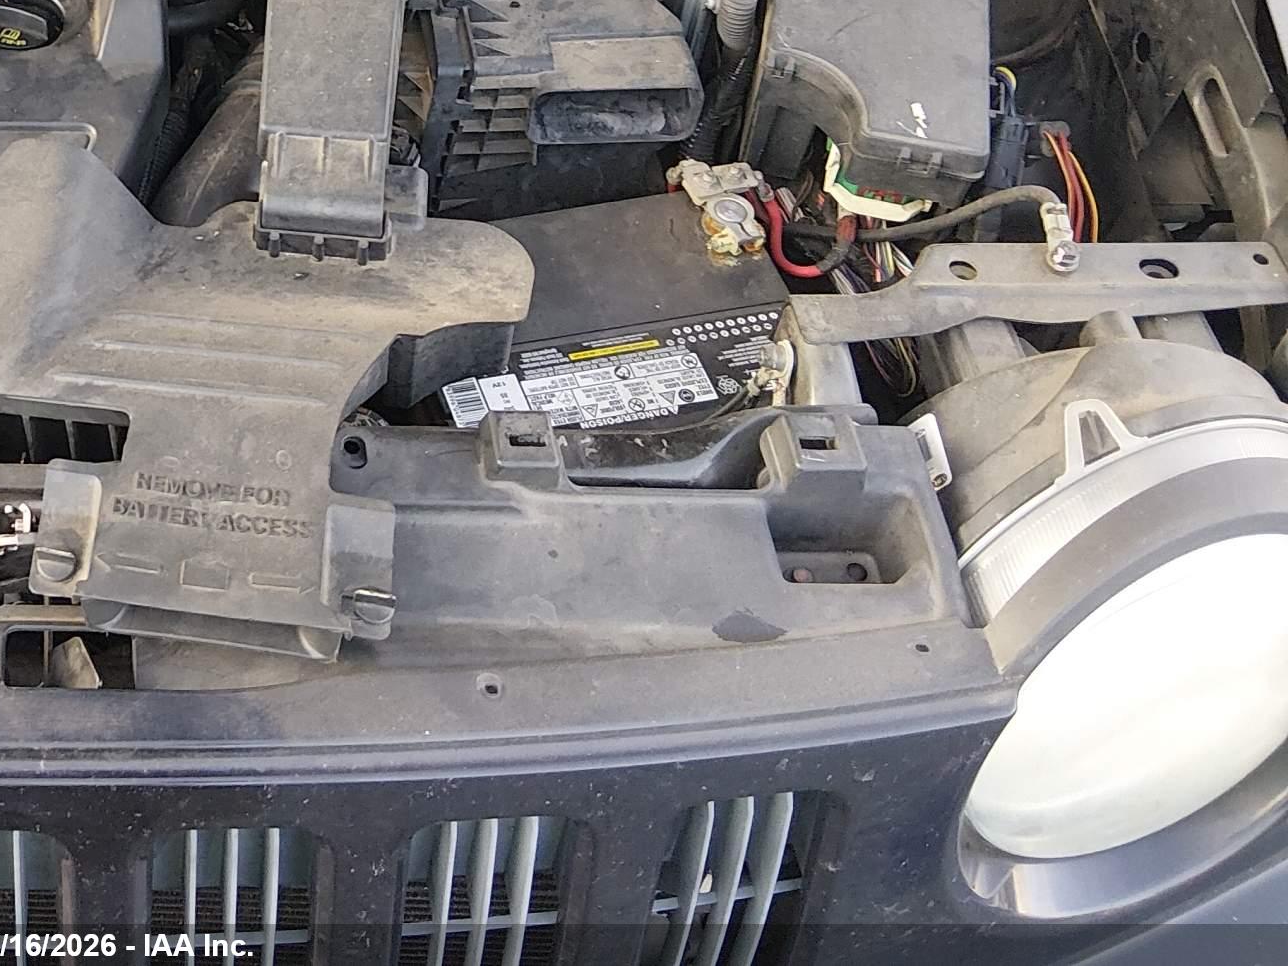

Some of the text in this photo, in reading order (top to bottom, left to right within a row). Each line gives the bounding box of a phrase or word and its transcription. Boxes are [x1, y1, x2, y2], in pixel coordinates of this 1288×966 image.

[580, 407, 669, 429] DANGER/POISON
[240, 486, 291, 507] FOR
[216, 512, 313, 539] ACCESS
